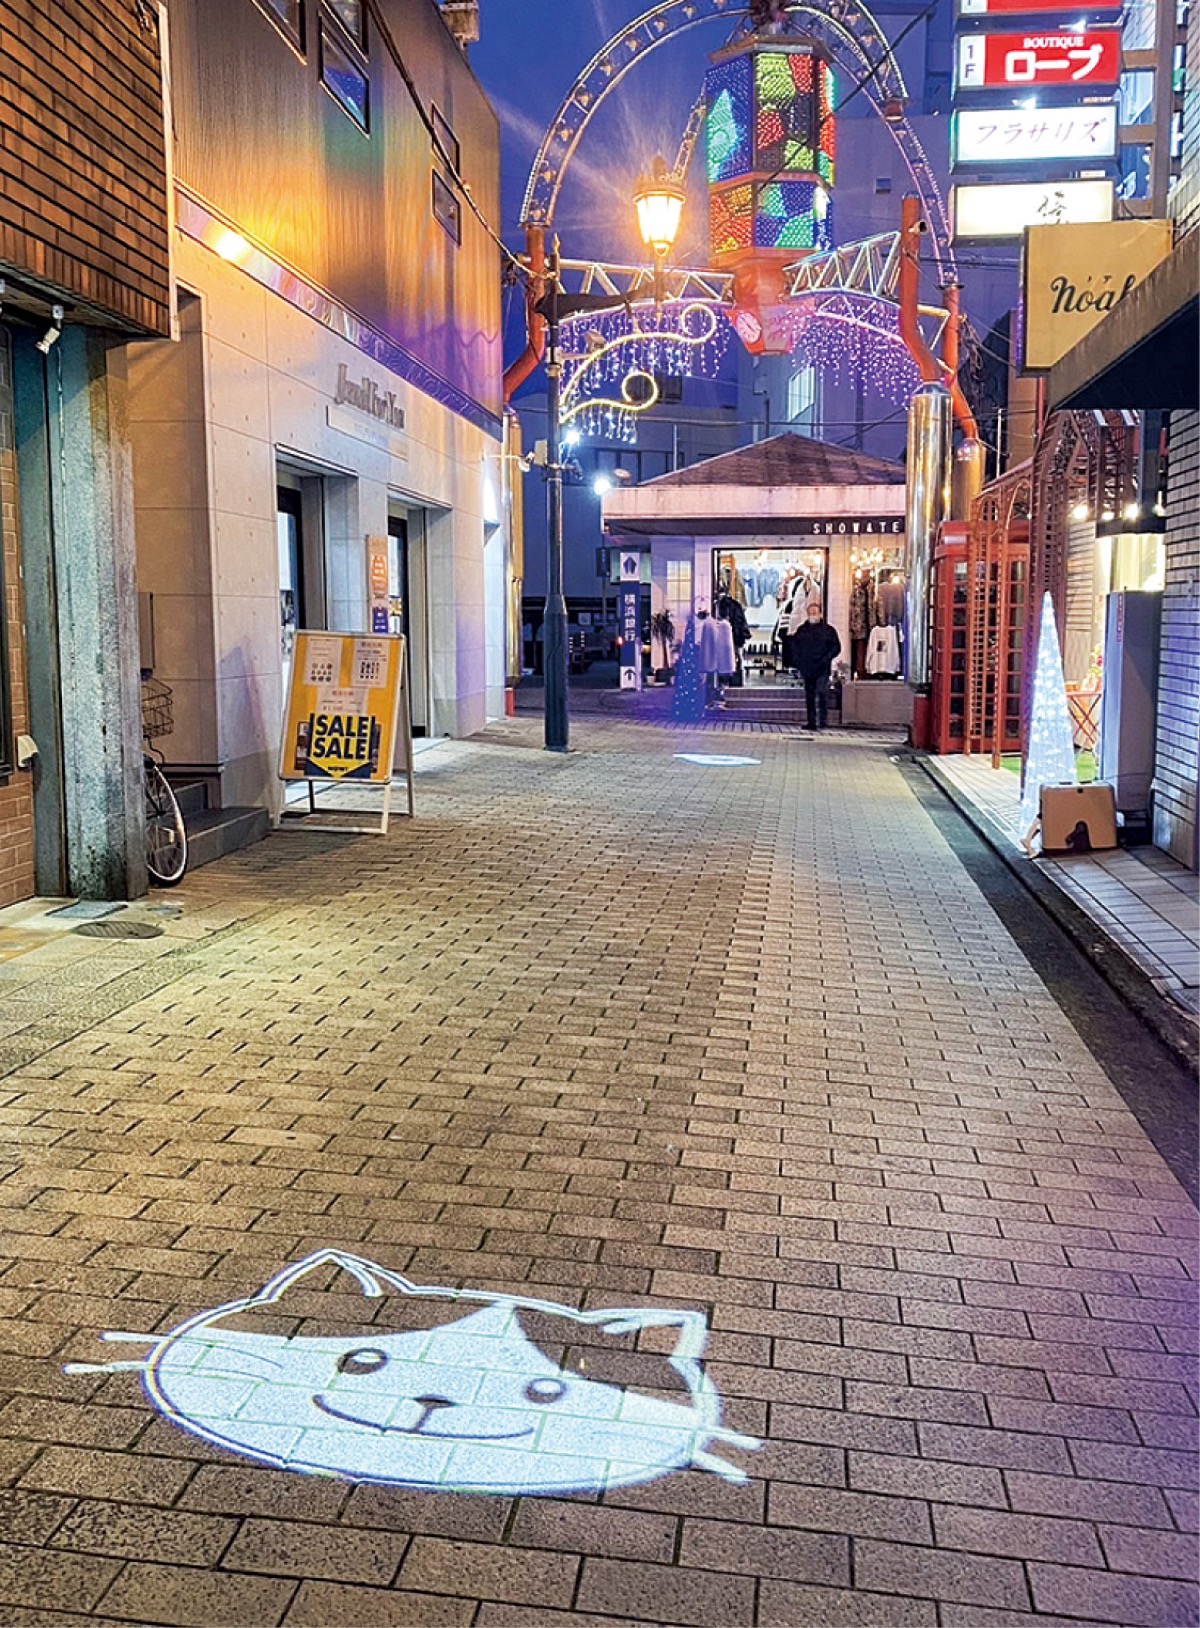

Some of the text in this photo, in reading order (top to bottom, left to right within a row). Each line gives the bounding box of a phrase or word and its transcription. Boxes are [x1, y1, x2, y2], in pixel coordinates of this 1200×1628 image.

[1023, 36, 1084, 49] BOUTIQUE
[965, 45, 976, 78] 1F
[315, 714, 369, 737] SALE
[313, 738, 367, 760] SALE
